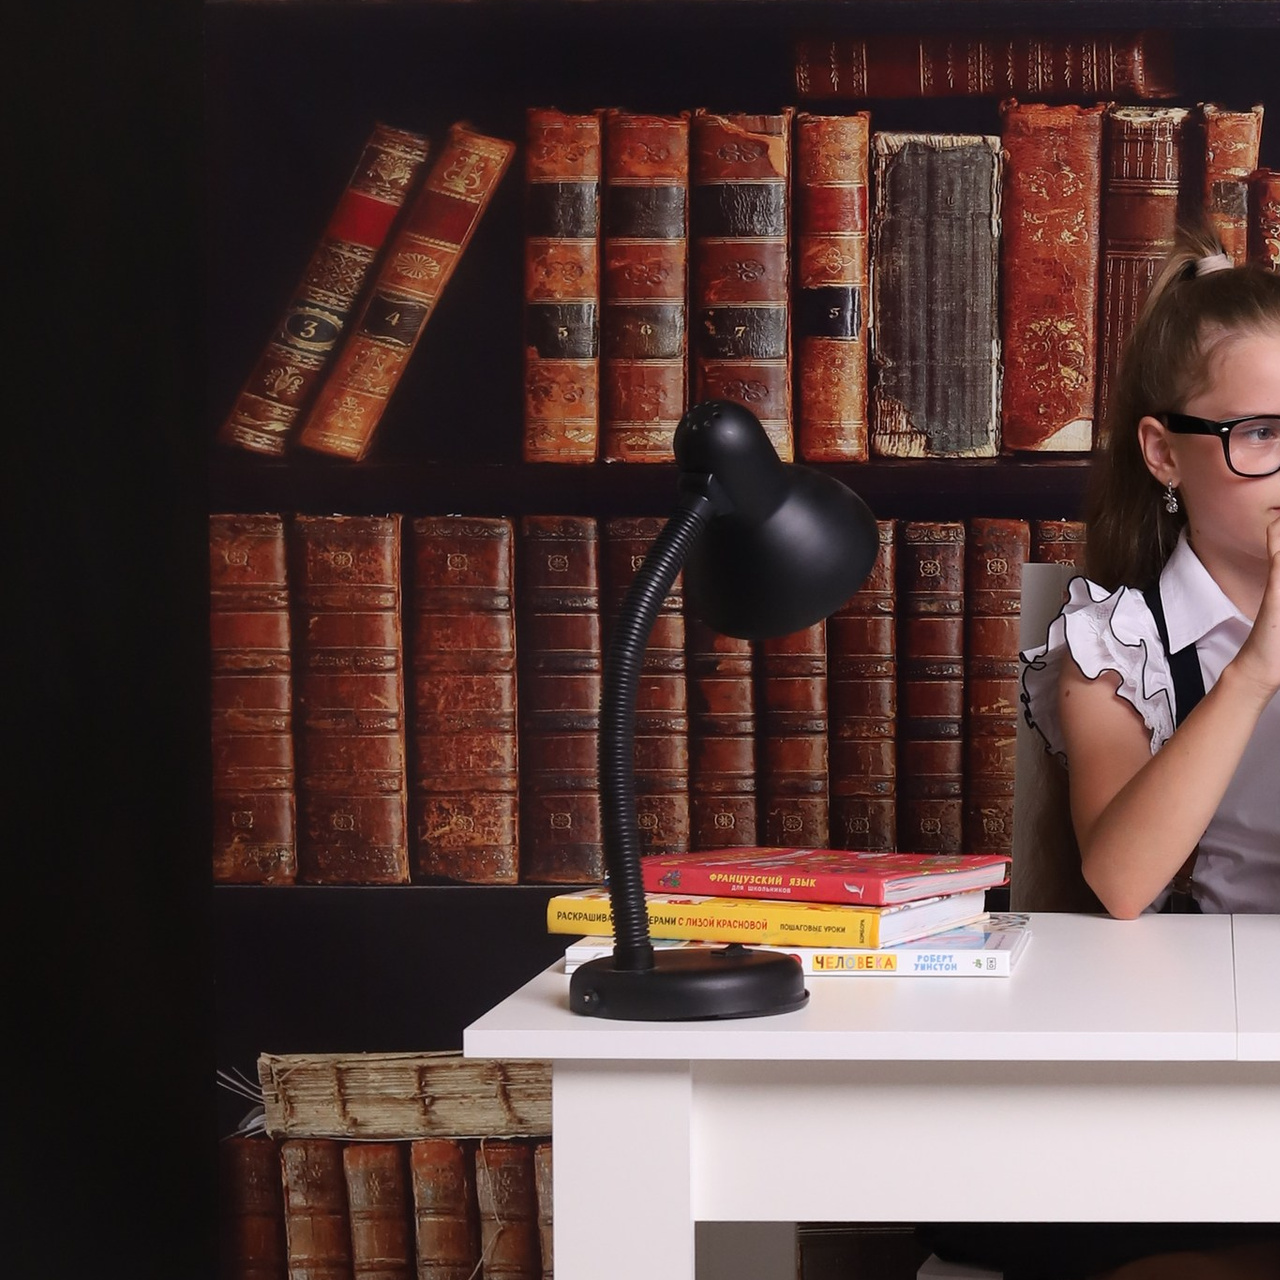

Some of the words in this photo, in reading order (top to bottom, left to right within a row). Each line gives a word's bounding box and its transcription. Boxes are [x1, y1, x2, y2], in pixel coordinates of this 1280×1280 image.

[384, 311, 400, 327] 4
[828, 307, 841, 319] 5
[299, 320, 319, 338] 3
[558, 326, 569, 337] 5
[640, 324, 653, 336] 6
[734, 325, 748, 338] 7
[709, 873, 783, 886] ФРАНЦУЗСКИЙ
[789, 878, 816, 888] ЯЗЫК
[556, 911, 613, 922] РАСКРАШИВА
[685, 916, 715, 928] ЛИЗОЙ
[716, 918, 768, 930] КРАСНОВОЙ
[779, 923, 822, 933] ПОШАГОВЫЕ
[824, 925, 846, 933] УРОКИ
[815, 956, 894, 969] ЧЕЛОВЕКА
[917, 954, 954, 963] РОБЕРТ
[914, 963, 958, 971] УИНСТОН
